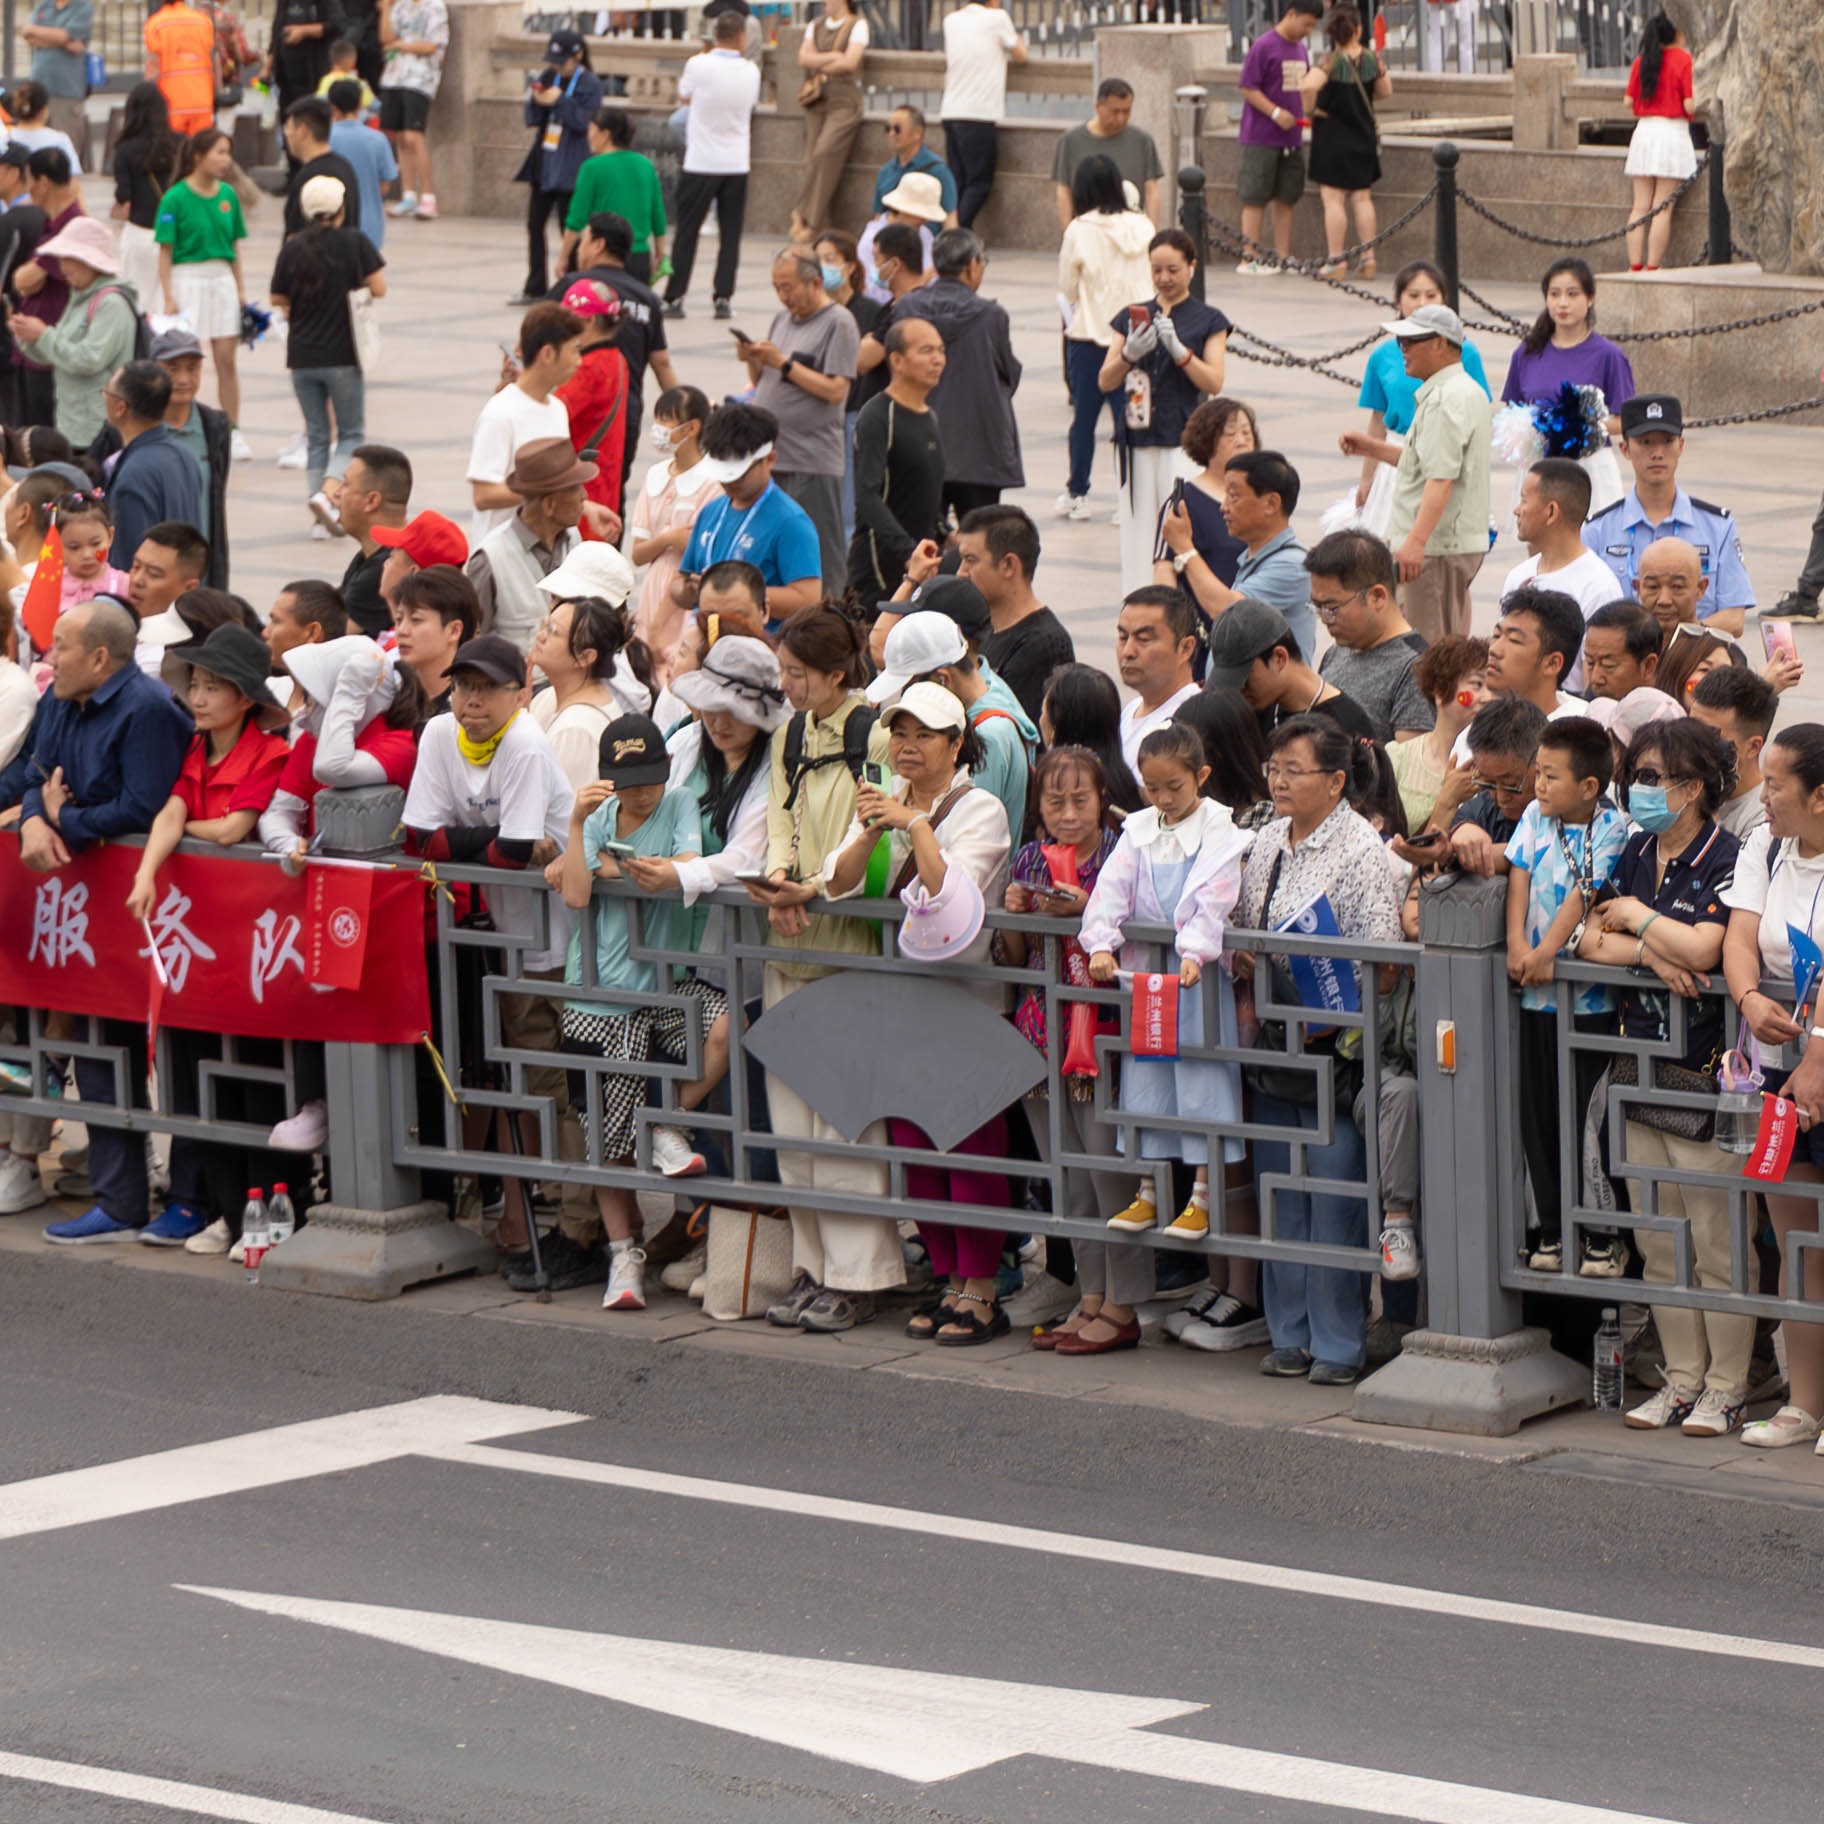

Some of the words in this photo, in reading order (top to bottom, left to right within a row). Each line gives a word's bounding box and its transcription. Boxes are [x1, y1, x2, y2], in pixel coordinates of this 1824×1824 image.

[1318, 955, 1345, 1013] 州银行
[1149, 995, 1163, 1050] 兰州银行
